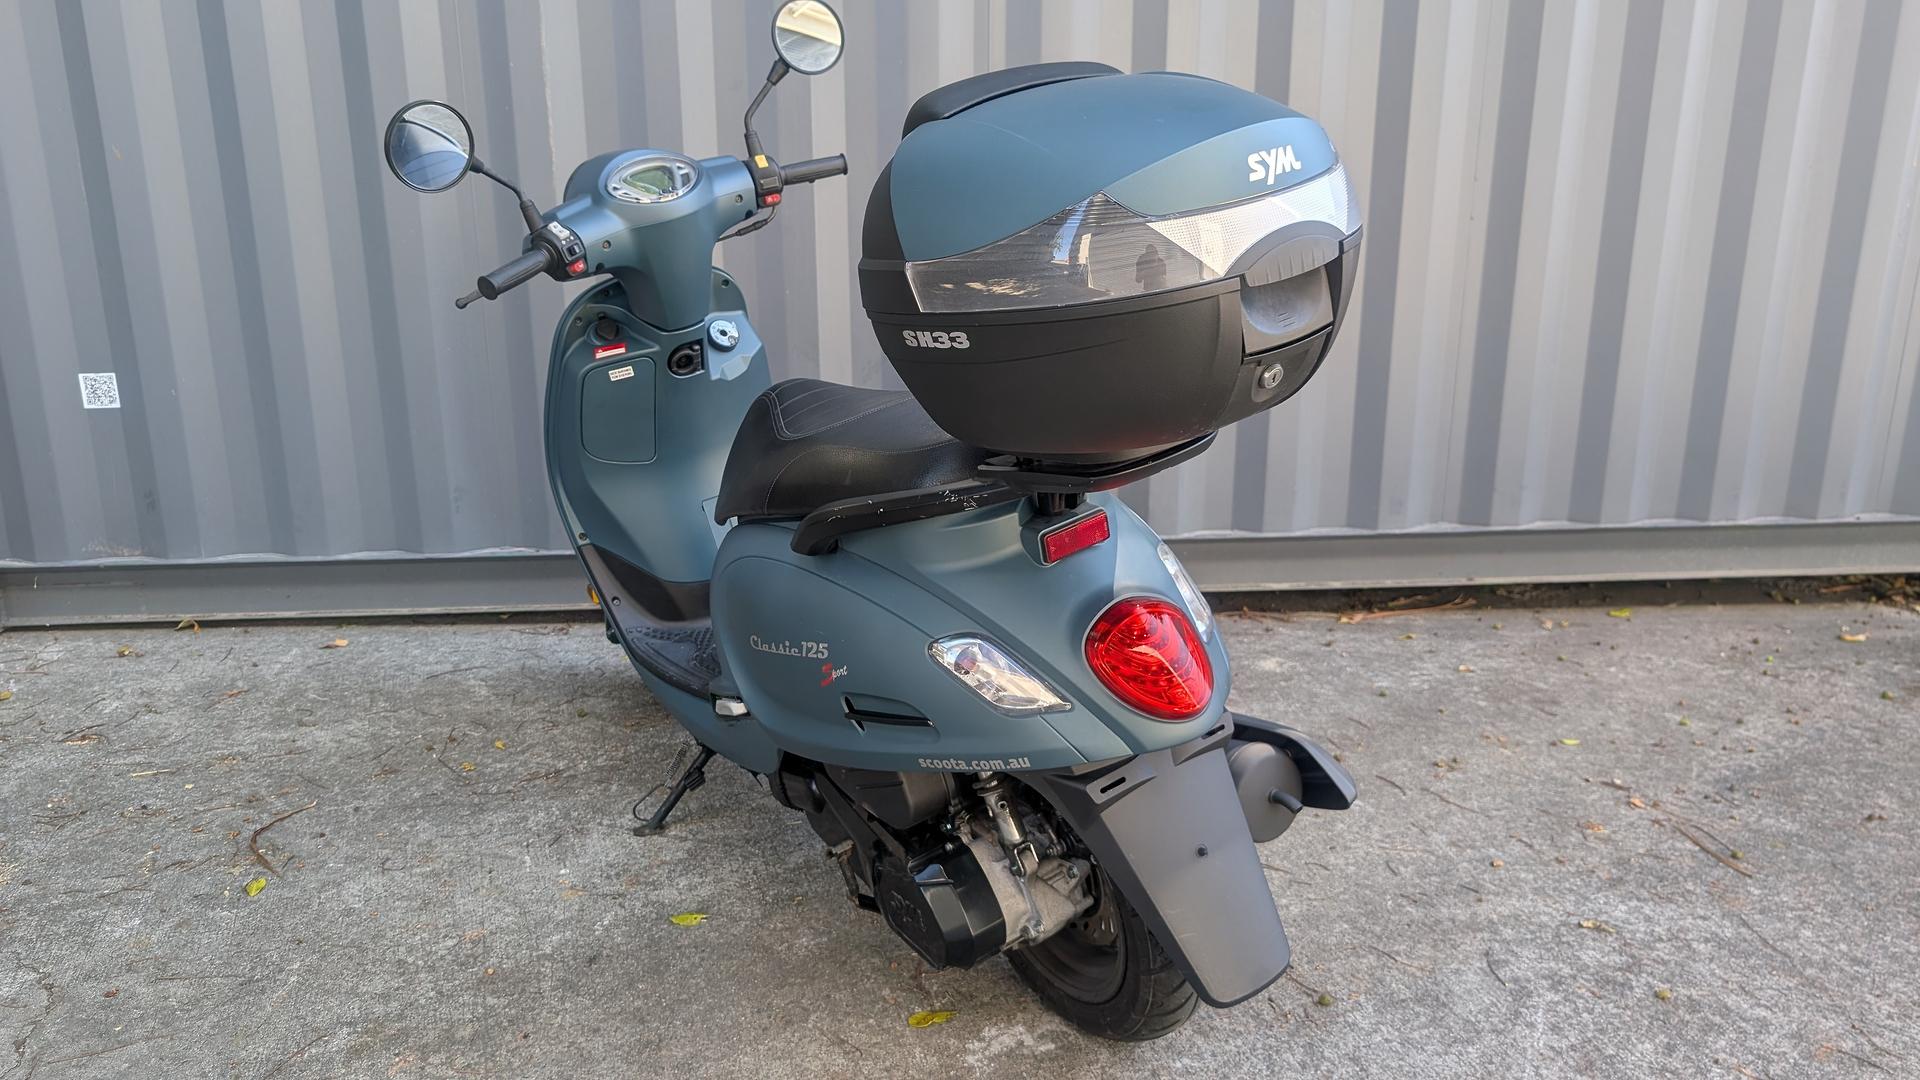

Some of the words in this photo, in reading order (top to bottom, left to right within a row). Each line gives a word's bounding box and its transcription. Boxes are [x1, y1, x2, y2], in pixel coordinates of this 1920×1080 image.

[1247, 144, 1302, 186] SYM
[902, 329, 970, 349] SH33
[821, 662, 848, 688] Sport
[918, 757, 1031, 770] scoota.com.au
